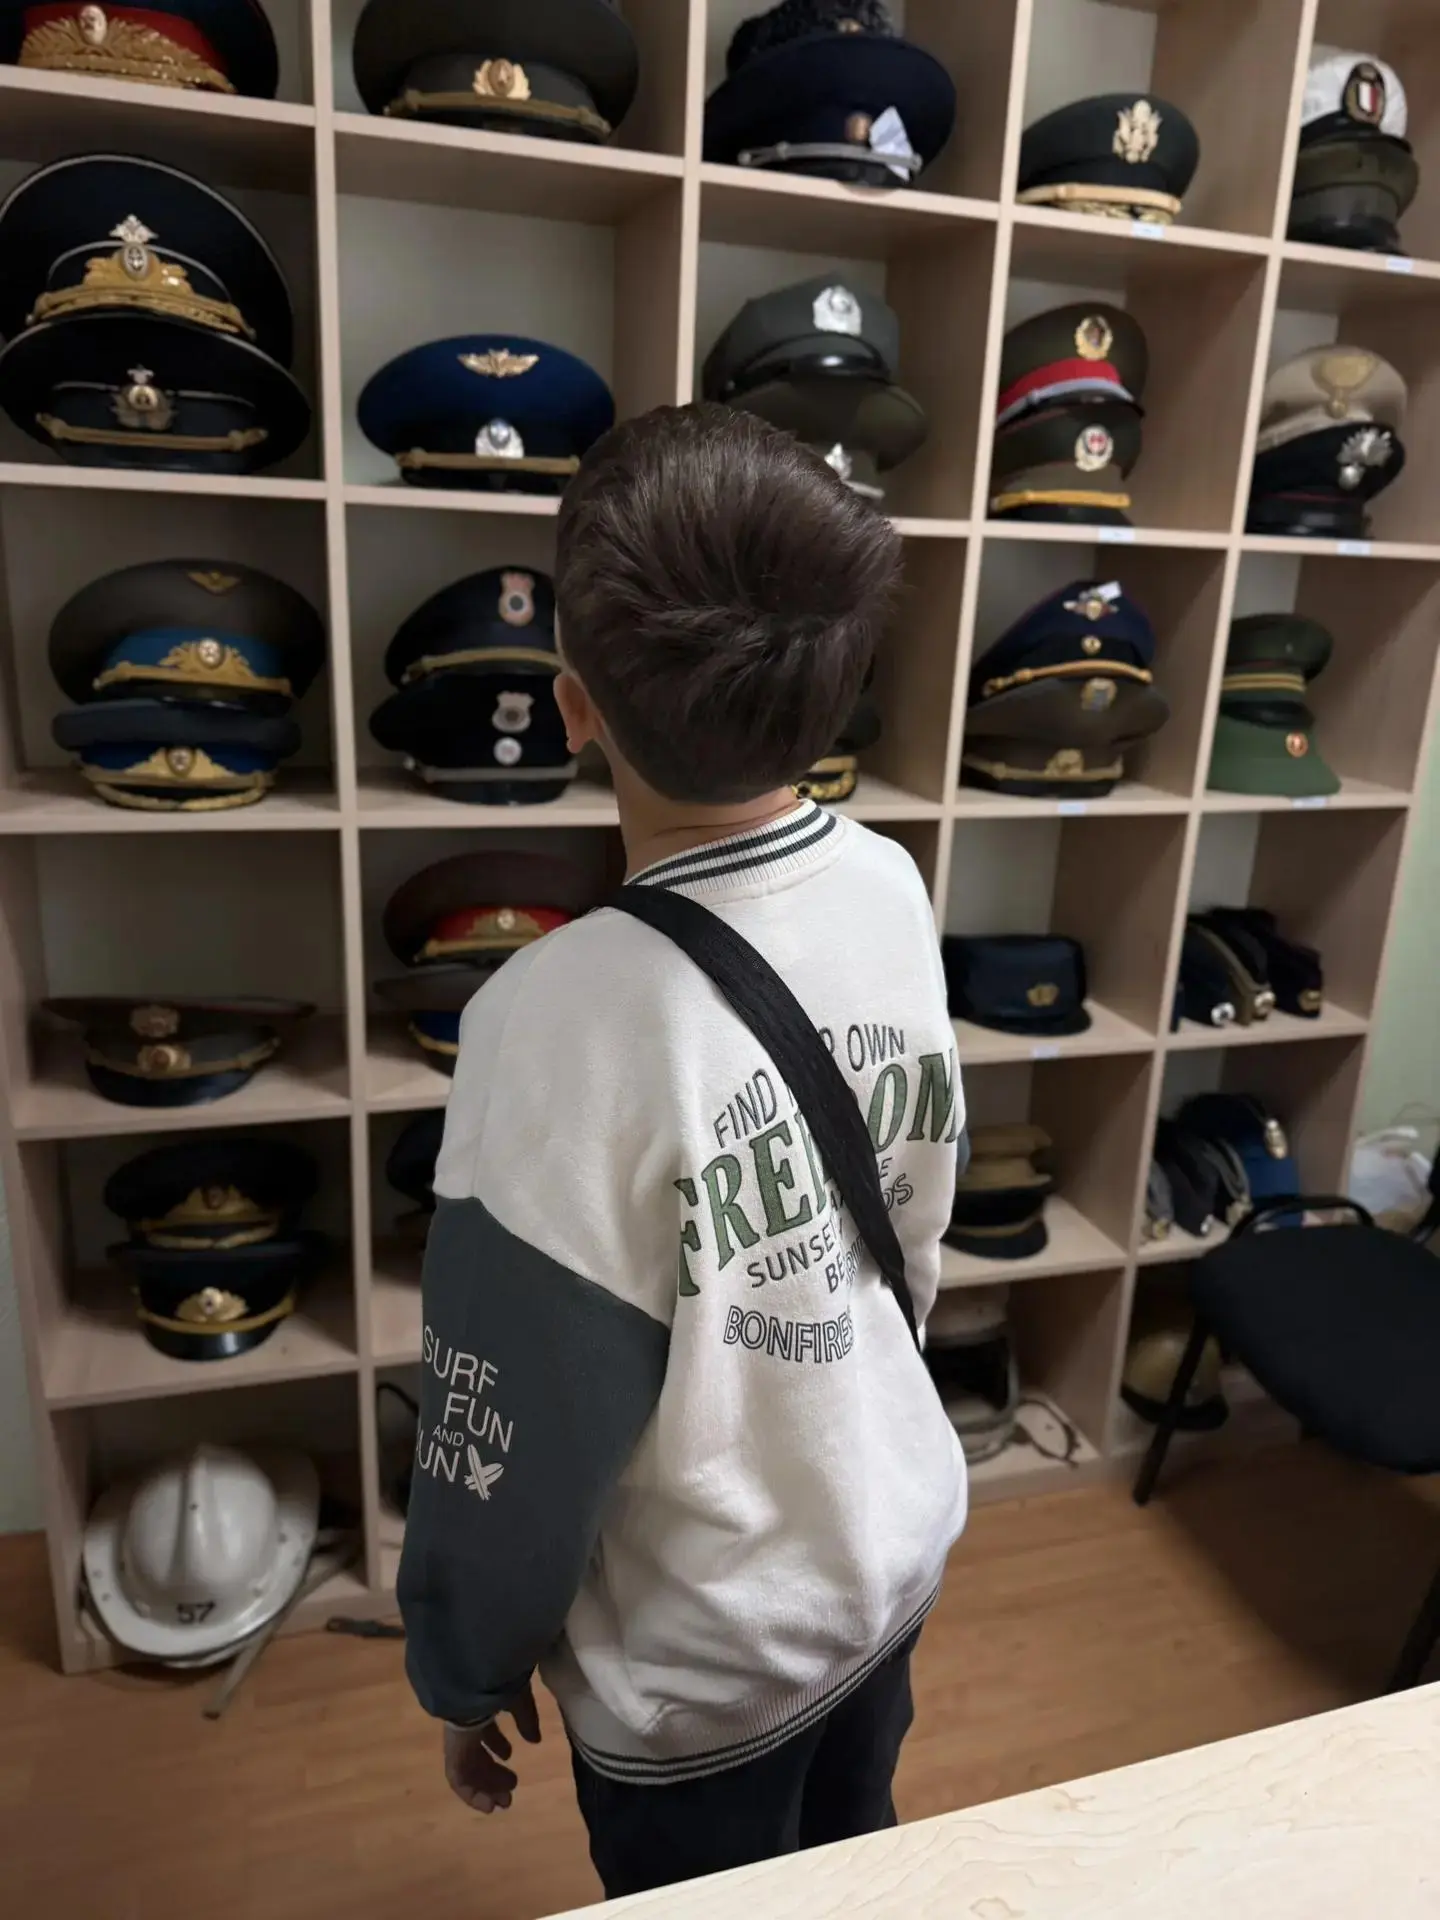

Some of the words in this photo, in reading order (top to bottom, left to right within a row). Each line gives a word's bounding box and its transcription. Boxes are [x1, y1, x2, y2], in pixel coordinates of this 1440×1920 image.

[713, 1068, 778, 1149] FIND
[847, 1023, 905, 1072] OWN
[674, 1048, 957, 1297] FREOM
[423, 1325, 499, 1394] SURF
[432, 1424, 465, 1447] AND
[443, 1391, 513, 1453] FUN
[415, 1428, 460, 1483] UN
[176, 1600, 216, 1625] 57
